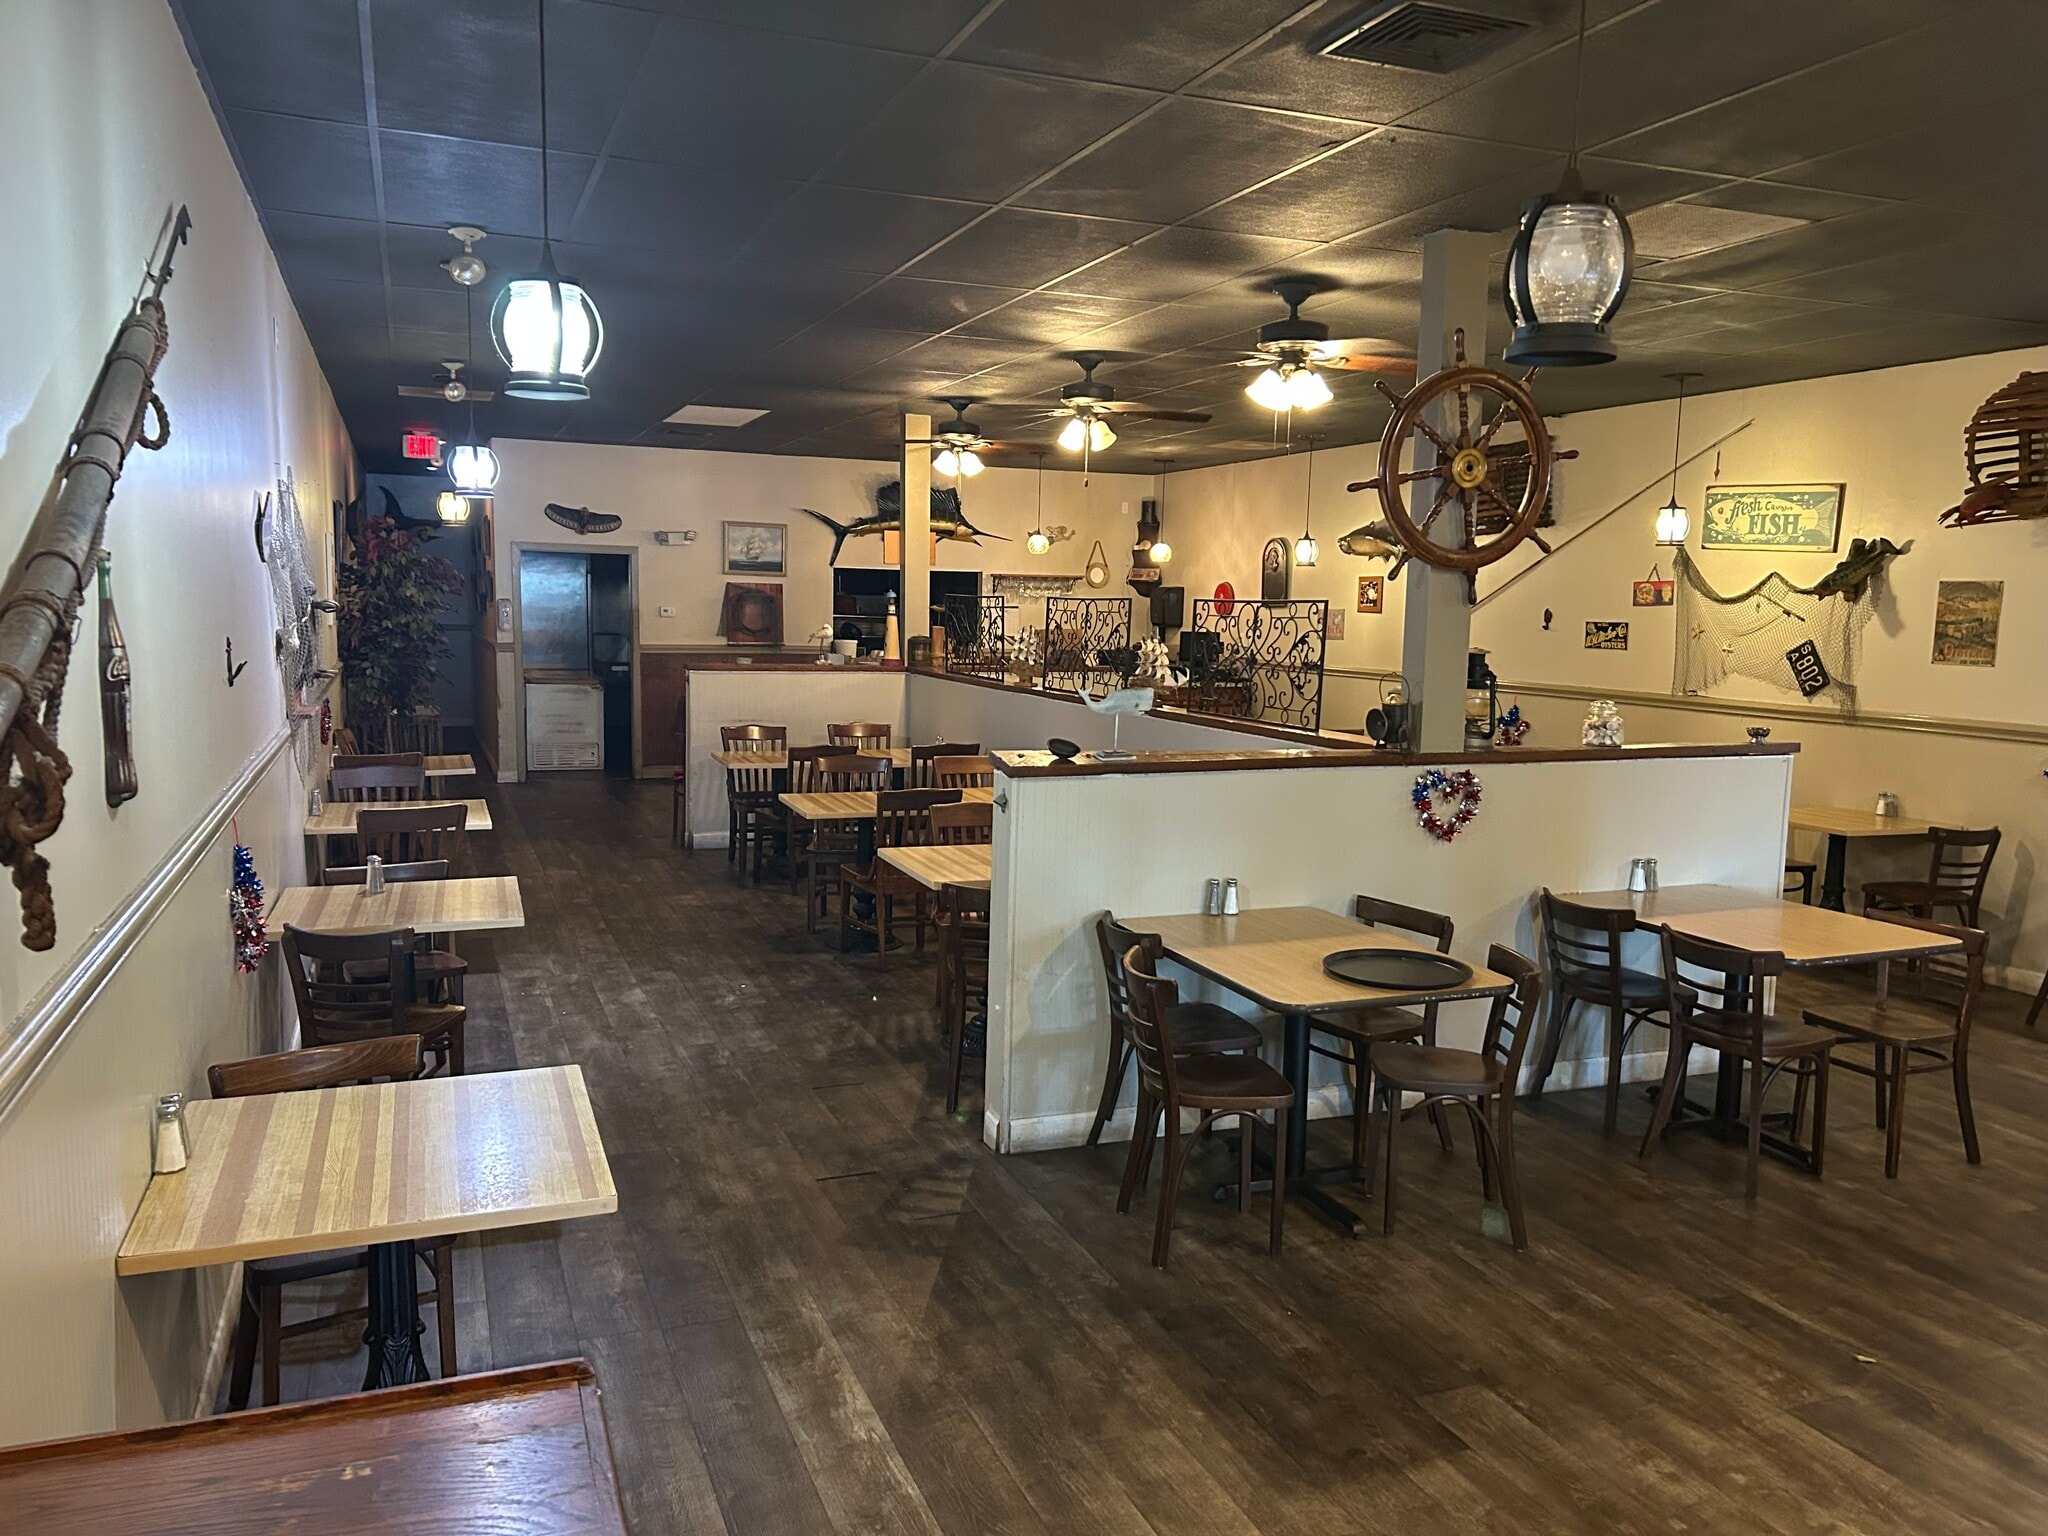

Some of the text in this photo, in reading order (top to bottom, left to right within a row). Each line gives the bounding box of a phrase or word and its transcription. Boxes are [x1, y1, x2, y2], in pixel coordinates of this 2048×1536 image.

[407, 435, 435, 457] EXIT
[1747, 513, 1802, 535] FISH
[1600, 641, 1626, 649] OYSTERS
[1796, 655, 1823, 691] 802
